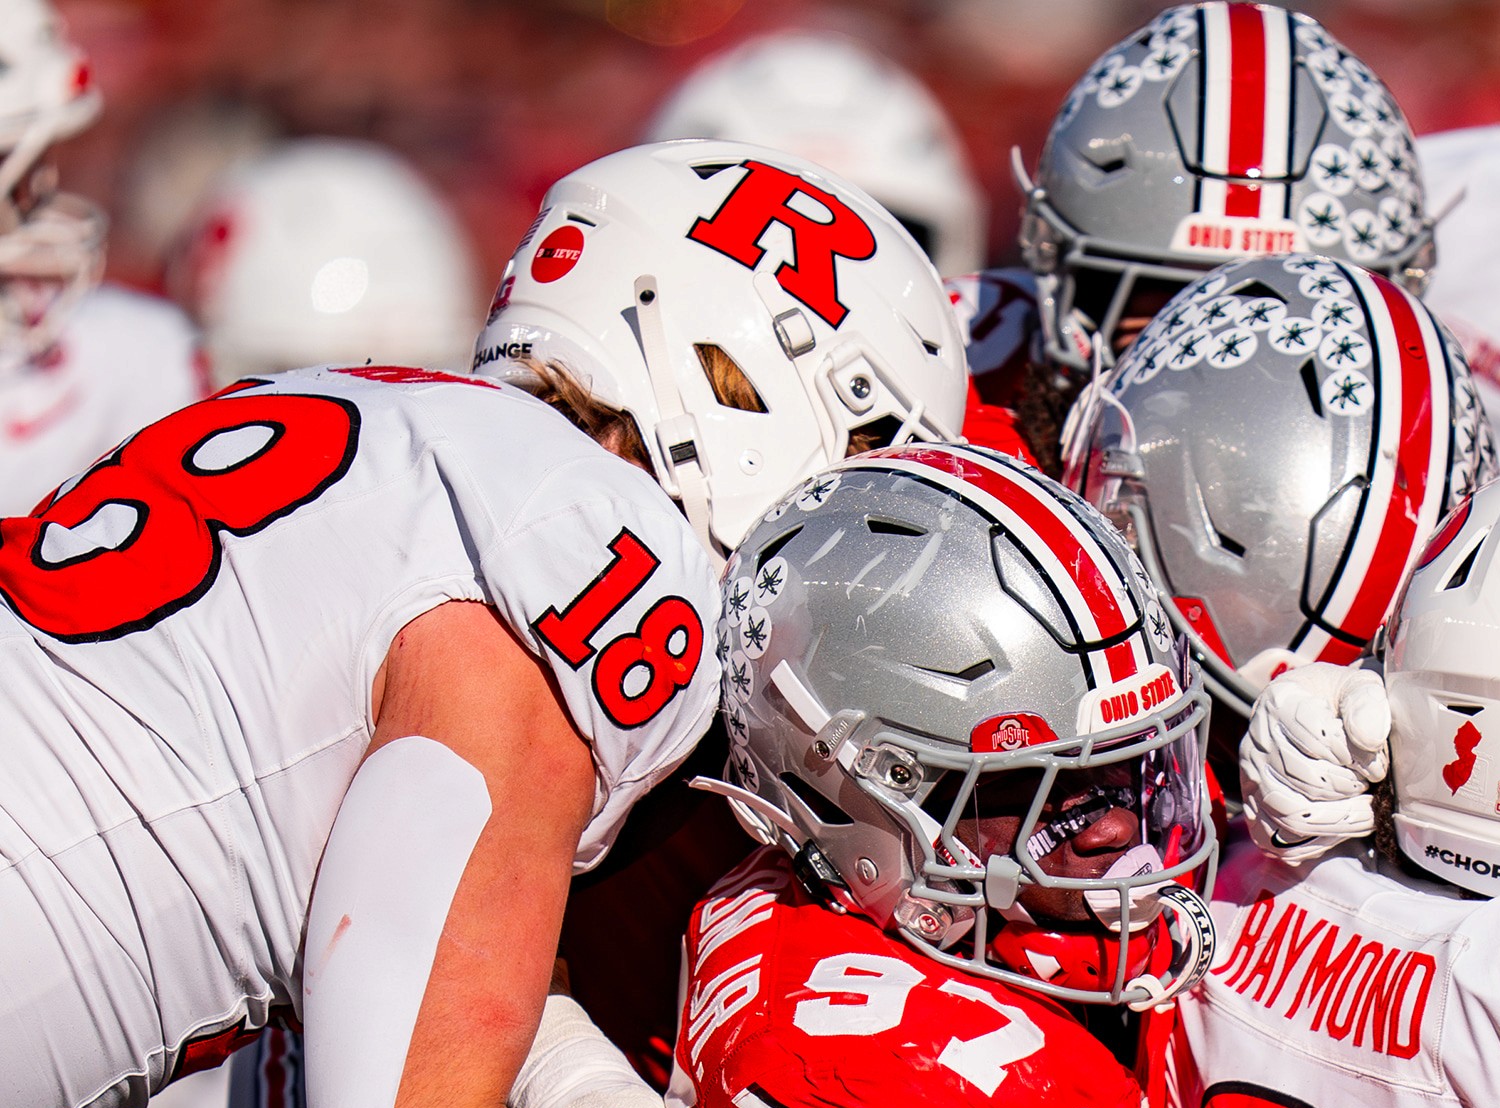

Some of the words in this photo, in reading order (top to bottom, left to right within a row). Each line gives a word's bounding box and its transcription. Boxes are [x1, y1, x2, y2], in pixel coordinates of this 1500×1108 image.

[685, 159, 877, 331] R
[1189, 225, 1233, 250] OHIO
[1242, 229, 1295, 253] STATE
[529, 526, 704, 731] 18
[1100, 690, 1139, 724] OHIO
[1140, 670, 1176, 711] STATE
[792, 952, 1046, 1098] 97
[1209, 888, 1437, 1060] RAYMOND
